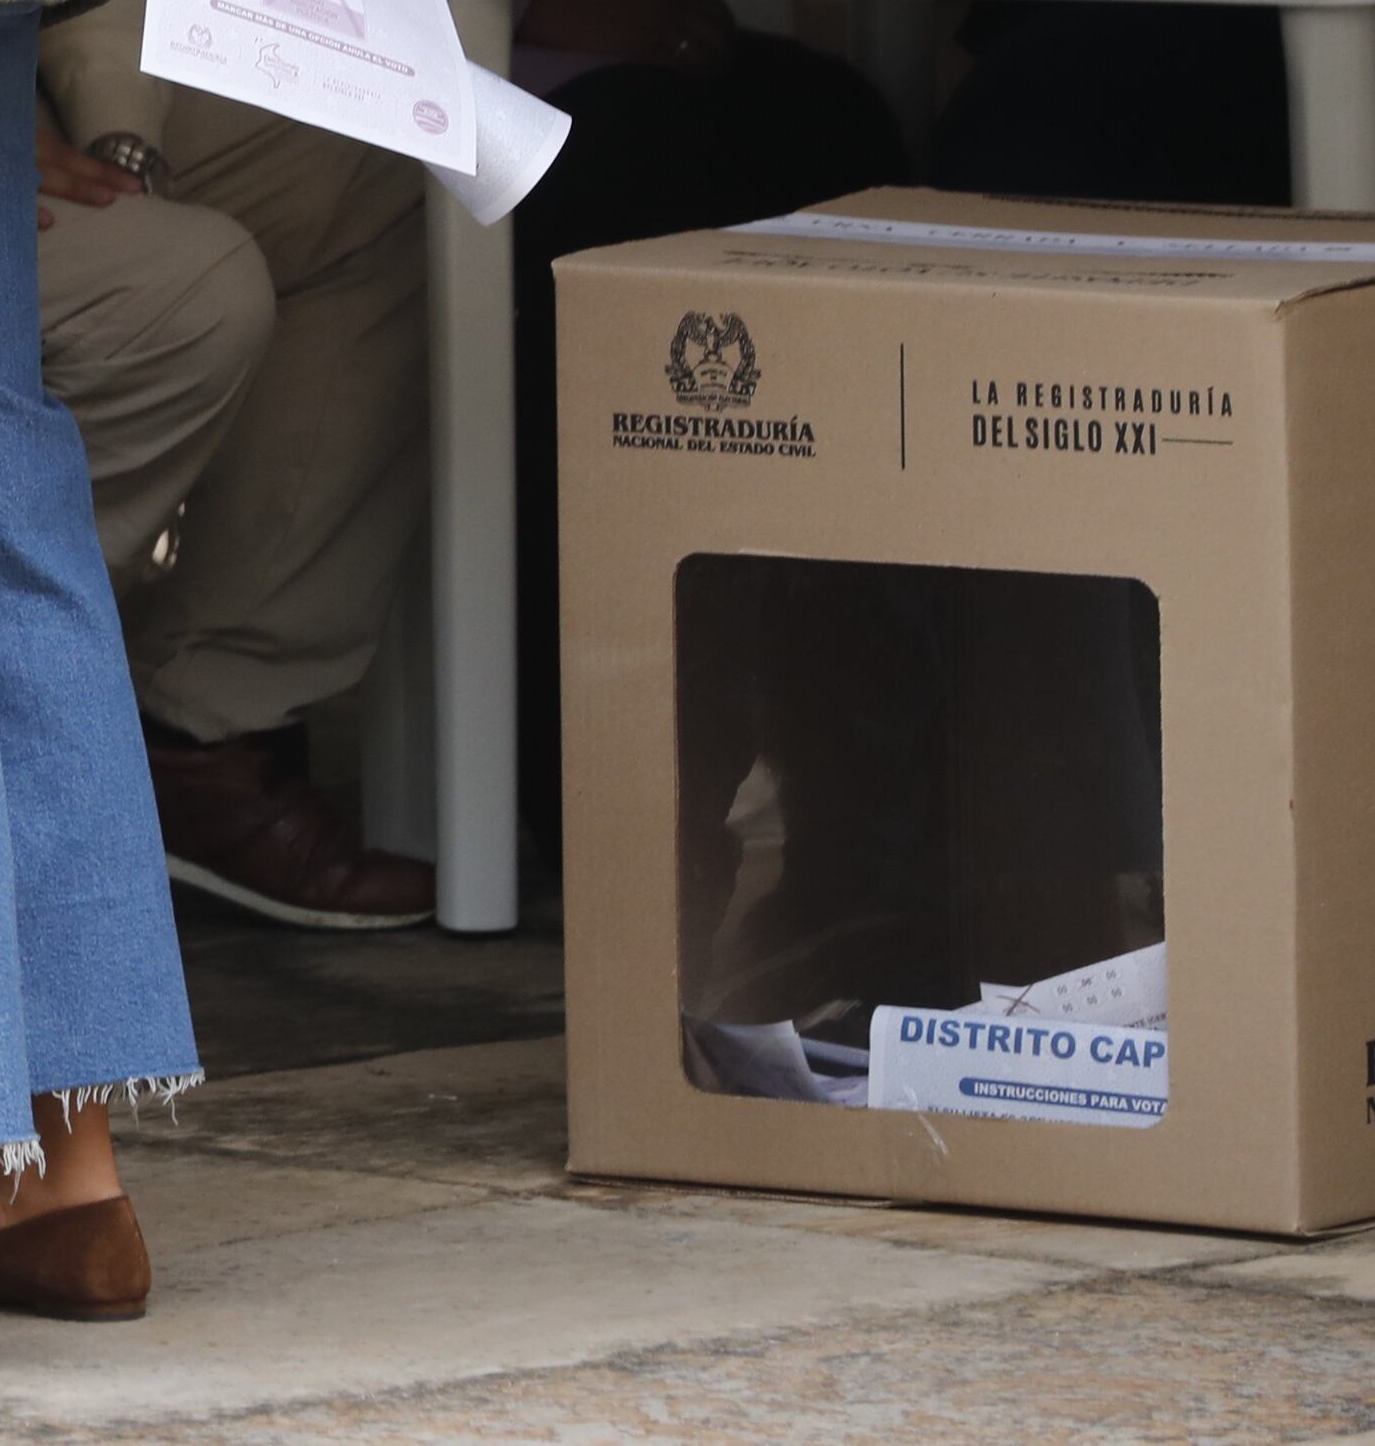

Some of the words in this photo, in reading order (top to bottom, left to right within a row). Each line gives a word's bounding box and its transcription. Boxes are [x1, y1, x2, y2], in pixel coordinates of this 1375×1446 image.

[288, 24, 307, 38] UNA
[342, 43, 371, 61] ANULA
[385, 59, 409, 74] VOTO
[972, 380, 999, 405] LA
[1016, 382, 1233, 417] REGISTRADURÍA
[612, 413, 815, 442] REGISTRADURÍA
[972, 414, 1019, 447] DEL
[1025, 417, 1102, 452] SIGLO
[1114, 422, 1156, 455] XXI
[613, 435, 683, 450] NACIONAL
[687, 440, 715, 452] DEL
[720, 440, 774, 455] ESTADO
[778, 444, 816, 458] CIVIL
[900, 1015, 1076, 1060] DISTRITO
[1089, 1036, 1165, 1068] CAP
[973, 1082, 1087, 1106] INSTRUCCIONES
[1090, 1094, 1128, 1110] PARA
